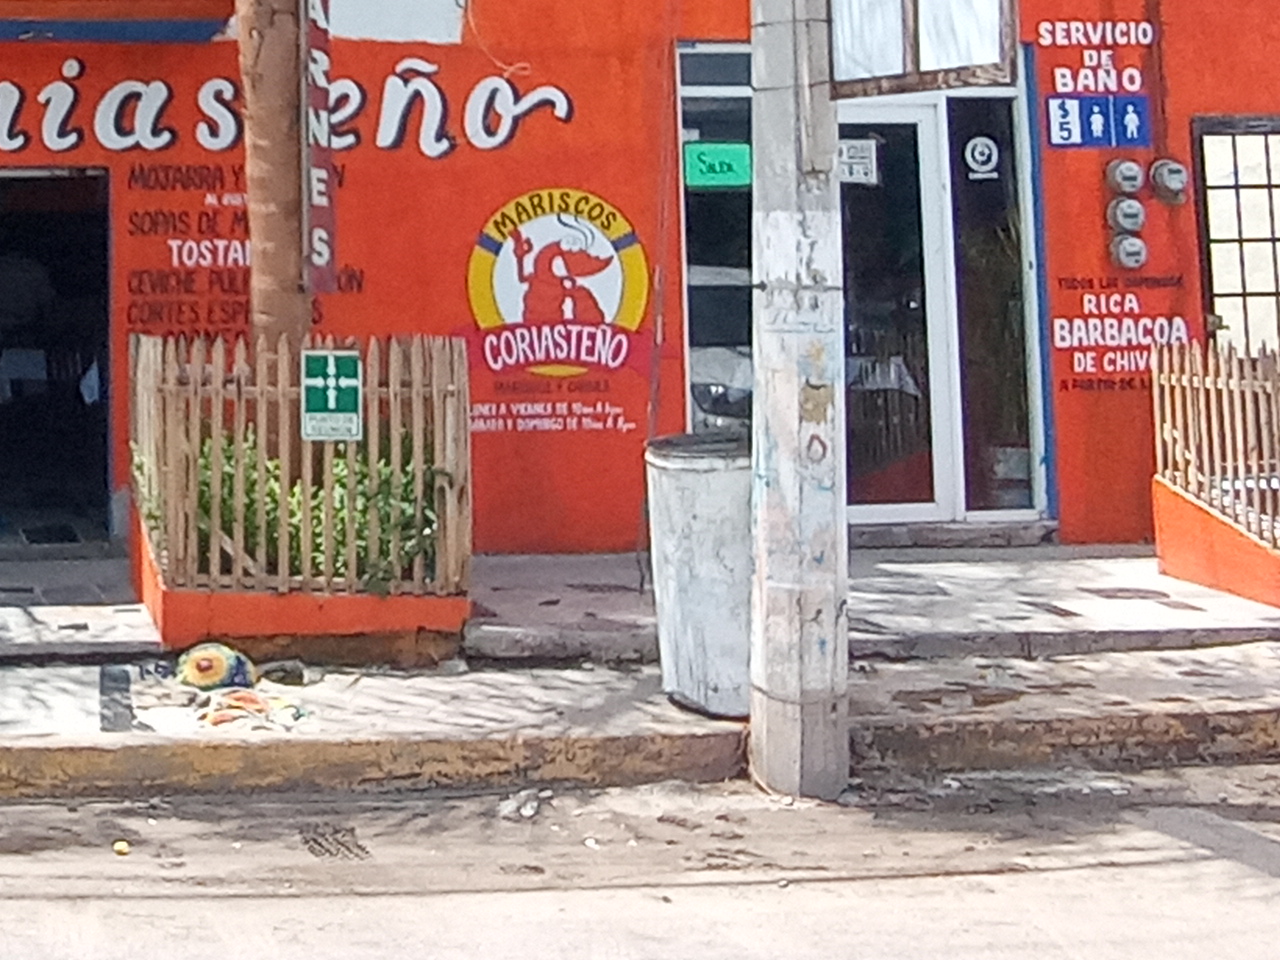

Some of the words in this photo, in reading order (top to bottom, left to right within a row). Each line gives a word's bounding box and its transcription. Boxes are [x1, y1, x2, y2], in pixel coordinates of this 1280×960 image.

[1038, 21, 1154, 46] SERVICIO
[1083, 49, 1114, 67] DE
[1059, 121, 1072, 141] 5
[493, 192, 618, 240] MARISCOS
[168, 239, 252, 267] TOSTA
[1083, 293, 1140, 314] RICA
[1053, 316, 1189, 348] BARBACOA
[484, 324, 629, 371] CORIASTEÑO
[1073, 351, 1097, 373] DE
[1103, 350, 1156, 372] CHIV
